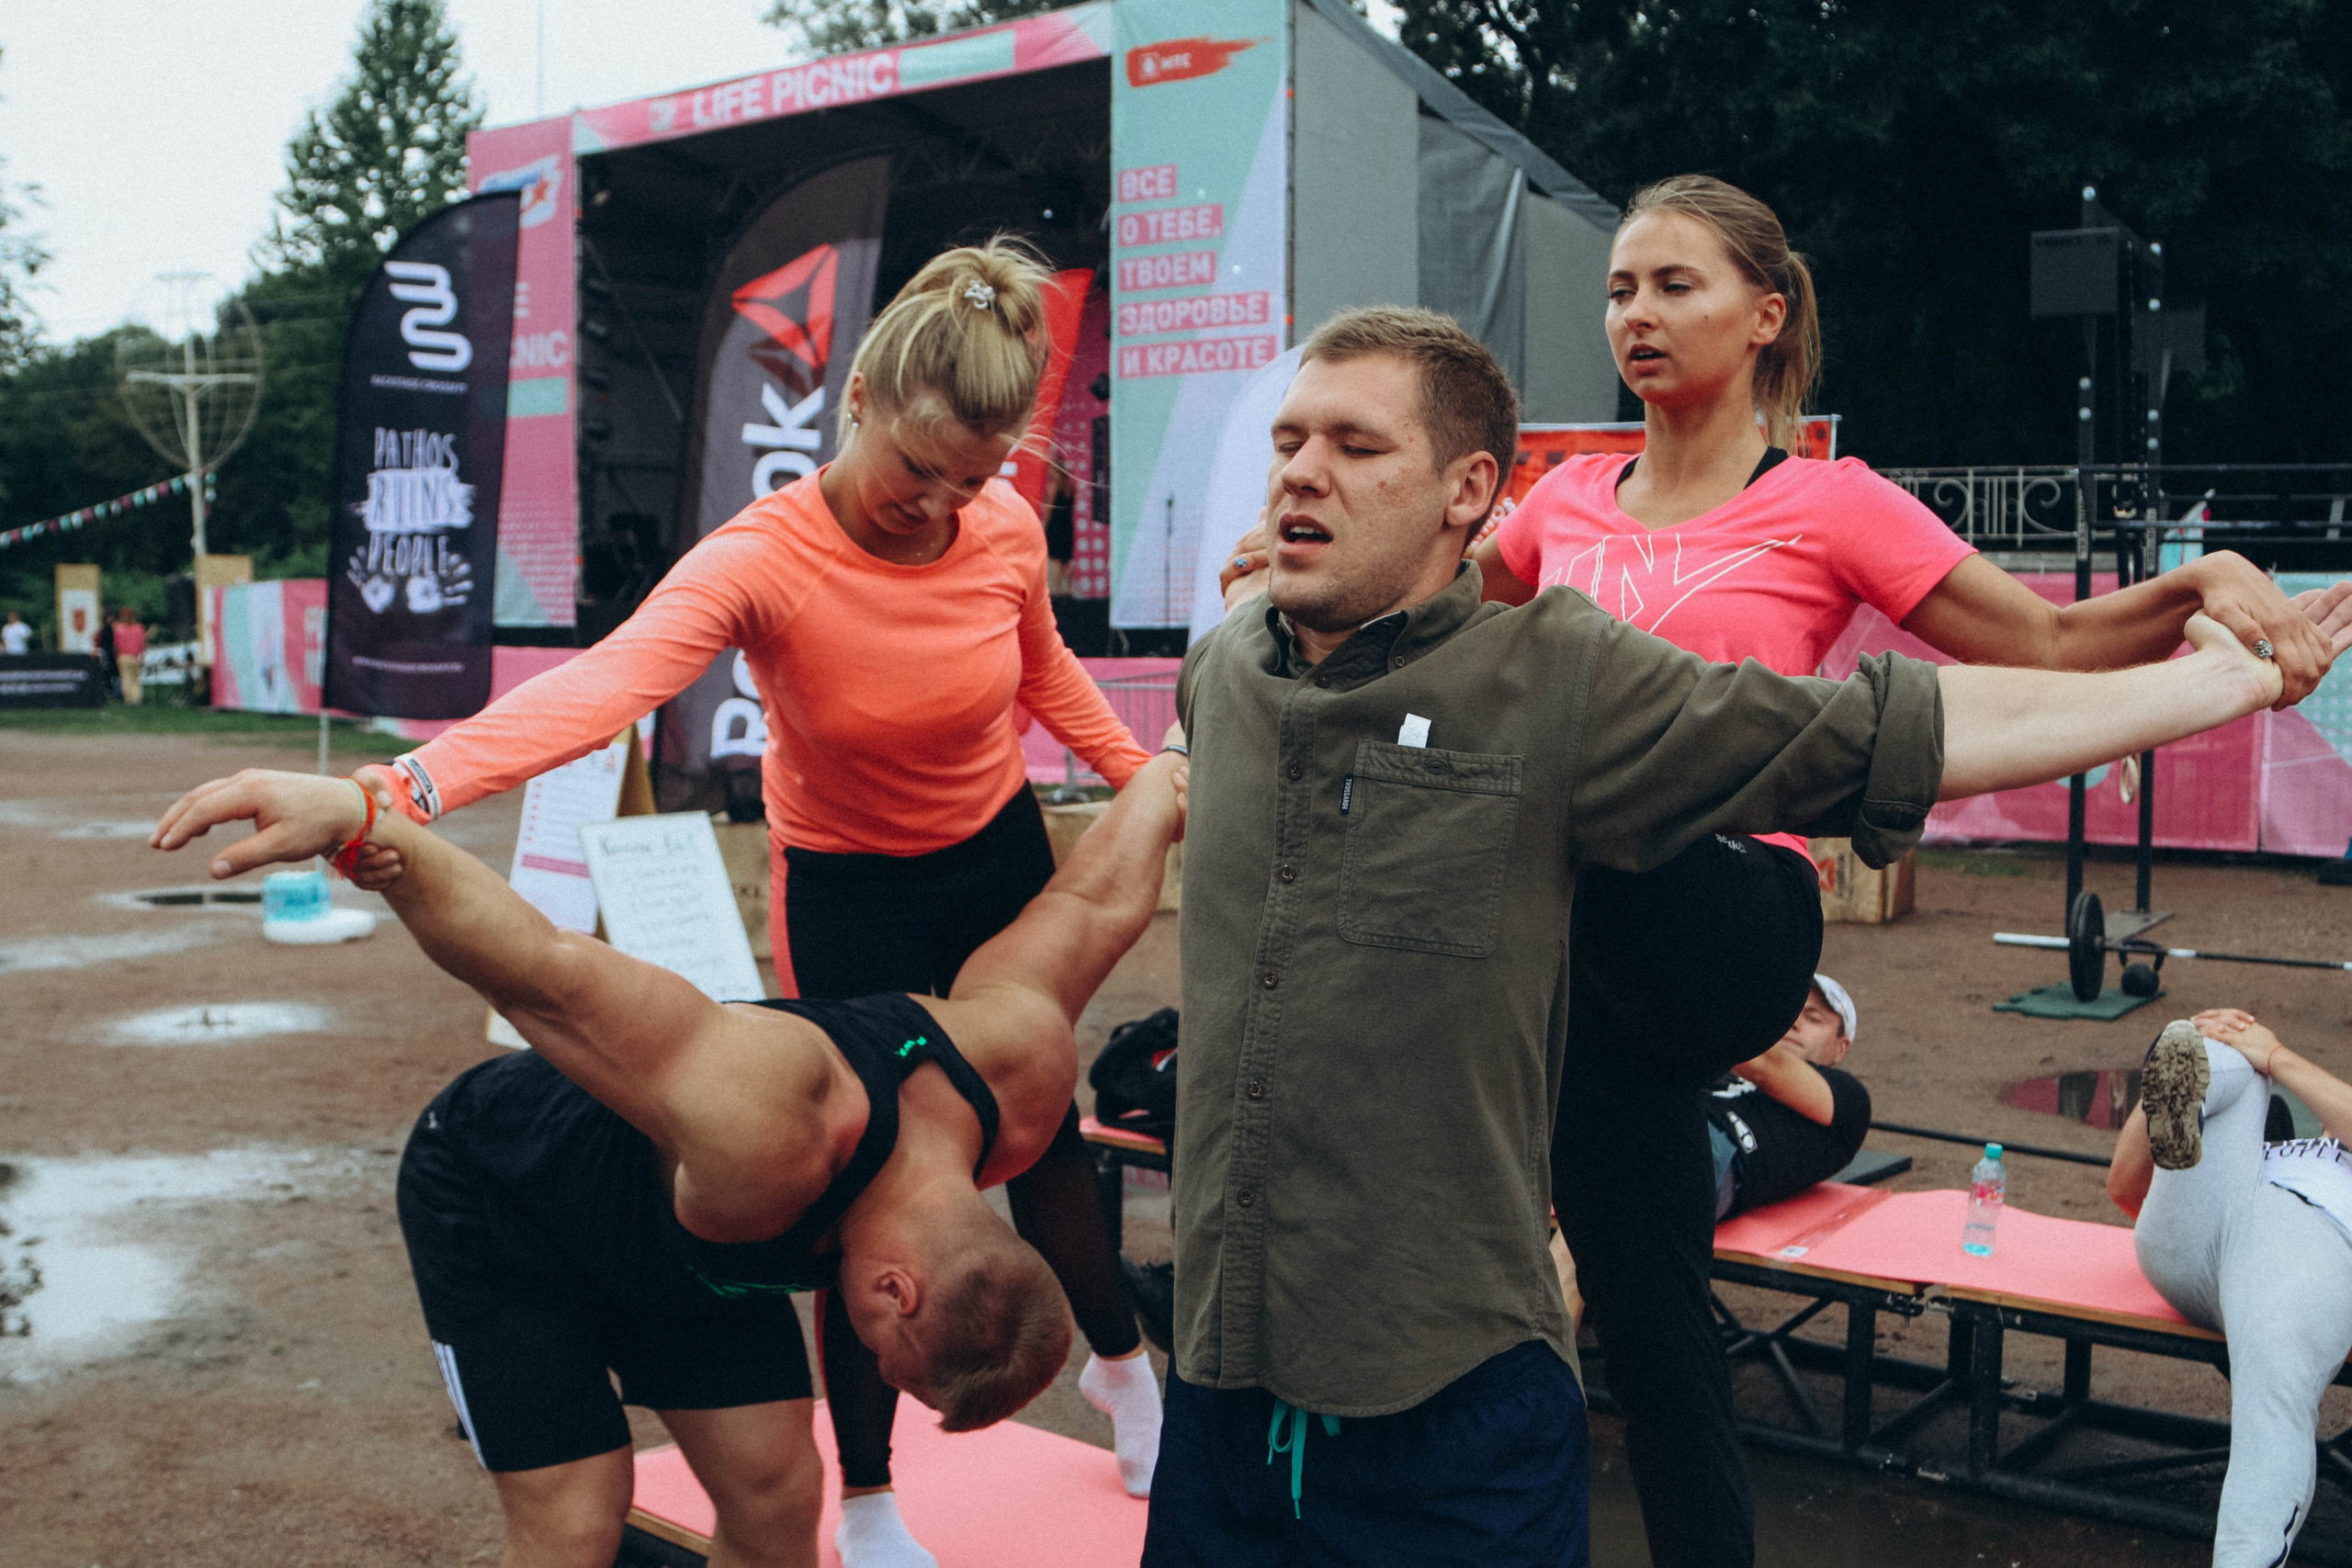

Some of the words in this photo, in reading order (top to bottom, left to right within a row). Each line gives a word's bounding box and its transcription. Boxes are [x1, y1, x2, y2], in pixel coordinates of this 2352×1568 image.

[692, 78, 764, 126] LIFE
[772, 53, 894, 111] PICNIC
[1121, 167, 1174, 199] ВСЕ
[1121, 217, 1139, 243] О
[1121, 255, 1211, 288] ТВОЕМ
[1121, 295, 1267, 333] ЗДОРОВЬЕ
[1121, 349, 1142, 375] И
[1148, 339, 1269, 372] КРАСОТЕ
[374, 426, 458, 472] PATHOS
[372, 474, 457, 525] RUINS
[368, 532, 450, 577] PEOPLE
[1342, 778, 1351, 809] TRUSSARDI
